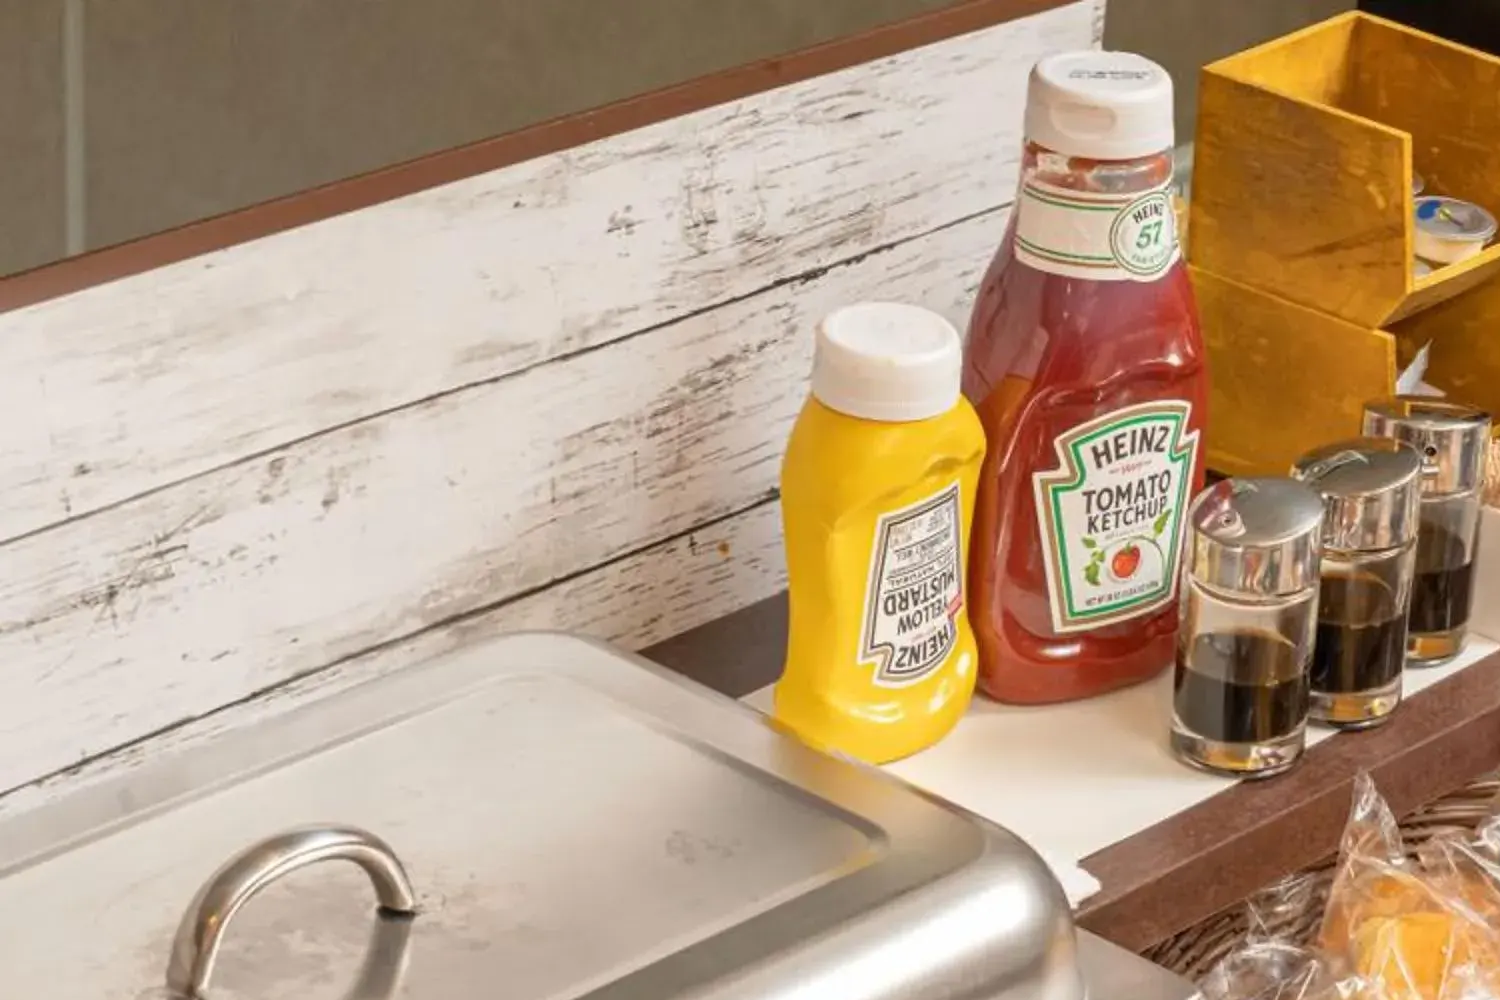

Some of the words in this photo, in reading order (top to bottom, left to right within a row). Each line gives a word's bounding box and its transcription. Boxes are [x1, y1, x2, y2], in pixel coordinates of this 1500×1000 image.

[1132, 202, 1164, 224] HEINZ
[1136, 219, 1163, 249] 57
[1091, 425, 1170, 469] HEINZ
[1081, 469, 1171, 515] TOMATO
[1086, 495, 1168, 535] KETCHUP
[882, 569, 955, 617] MUSTARD
[895, 624, 949, 668] HEINZ
